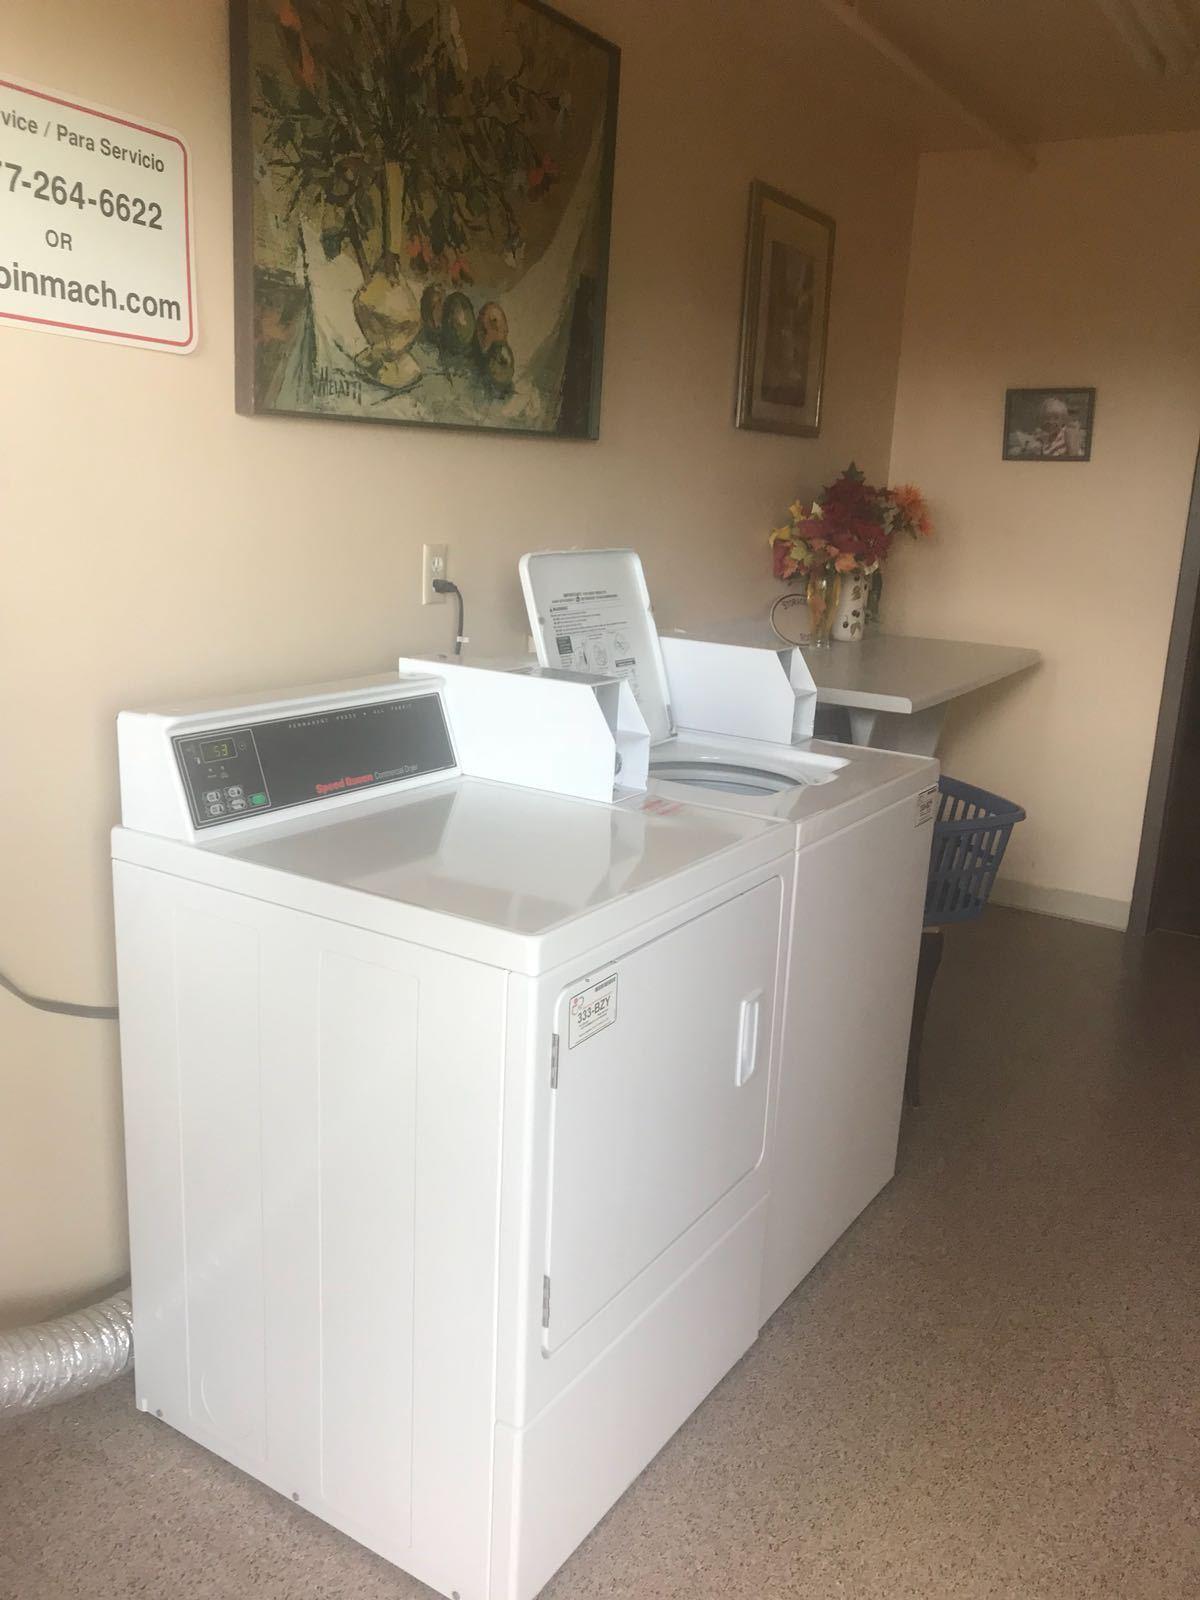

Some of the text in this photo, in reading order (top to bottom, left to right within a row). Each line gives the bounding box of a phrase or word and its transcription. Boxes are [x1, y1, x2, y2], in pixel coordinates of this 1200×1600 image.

[0, 109, 38, 134] vice
[56, 124, 95, 152] Para
[100, 138, 165, 173] Servicio
[0, 160, 163, 230] 7-264-6622
[45, 229, 73, 251] OR
[577, 996, 611, 1023] 333-BZY
